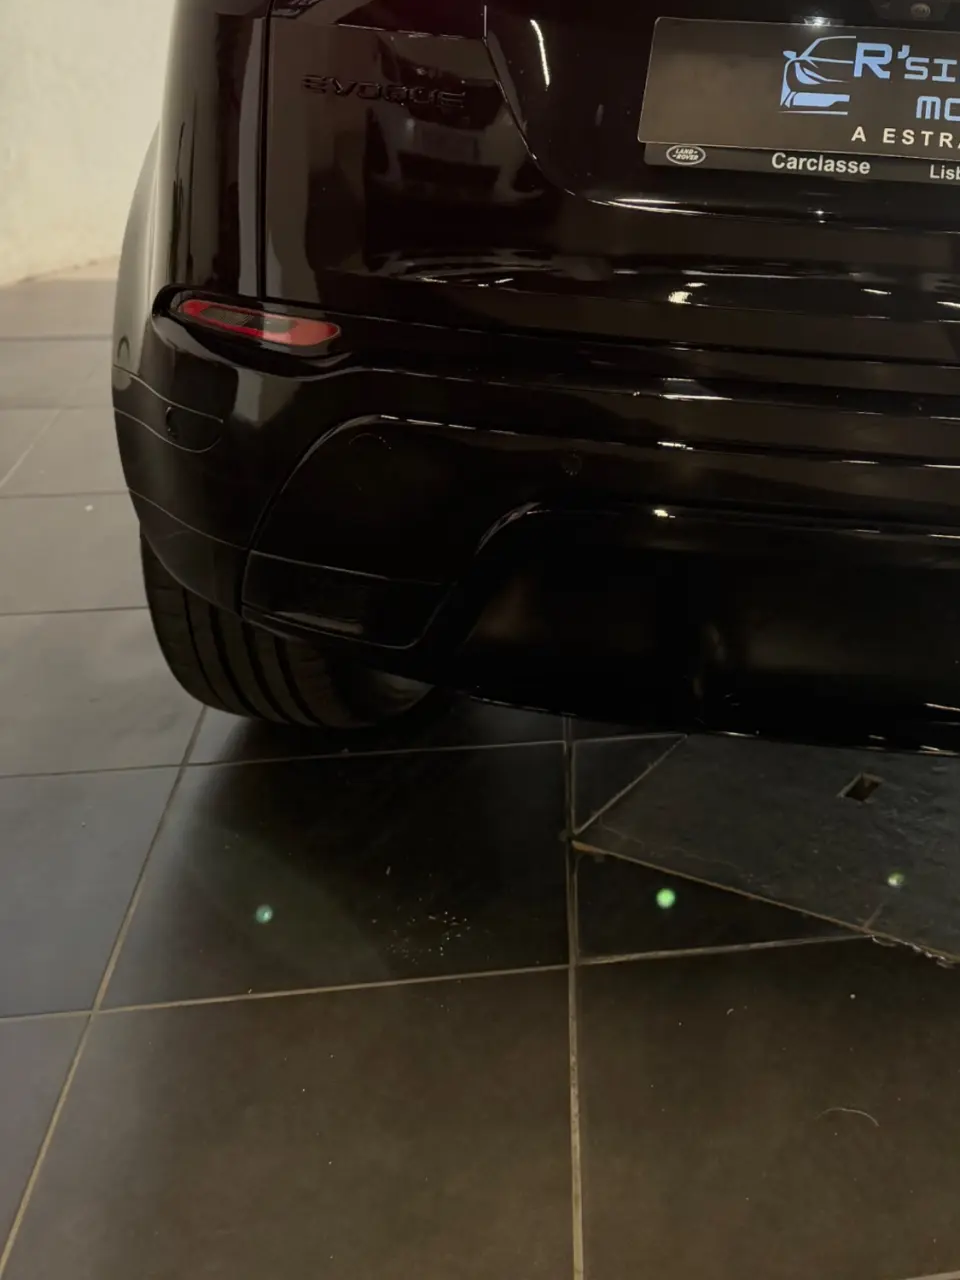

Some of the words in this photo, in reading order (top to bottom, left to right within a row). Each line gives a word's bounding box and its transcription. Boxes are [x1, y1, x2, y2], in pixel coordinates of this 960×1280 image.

[302, 75, 466, 108] EVOQUE
[851, 126, 867, 142] A
[771, 152, 871, 175] Carclasse
